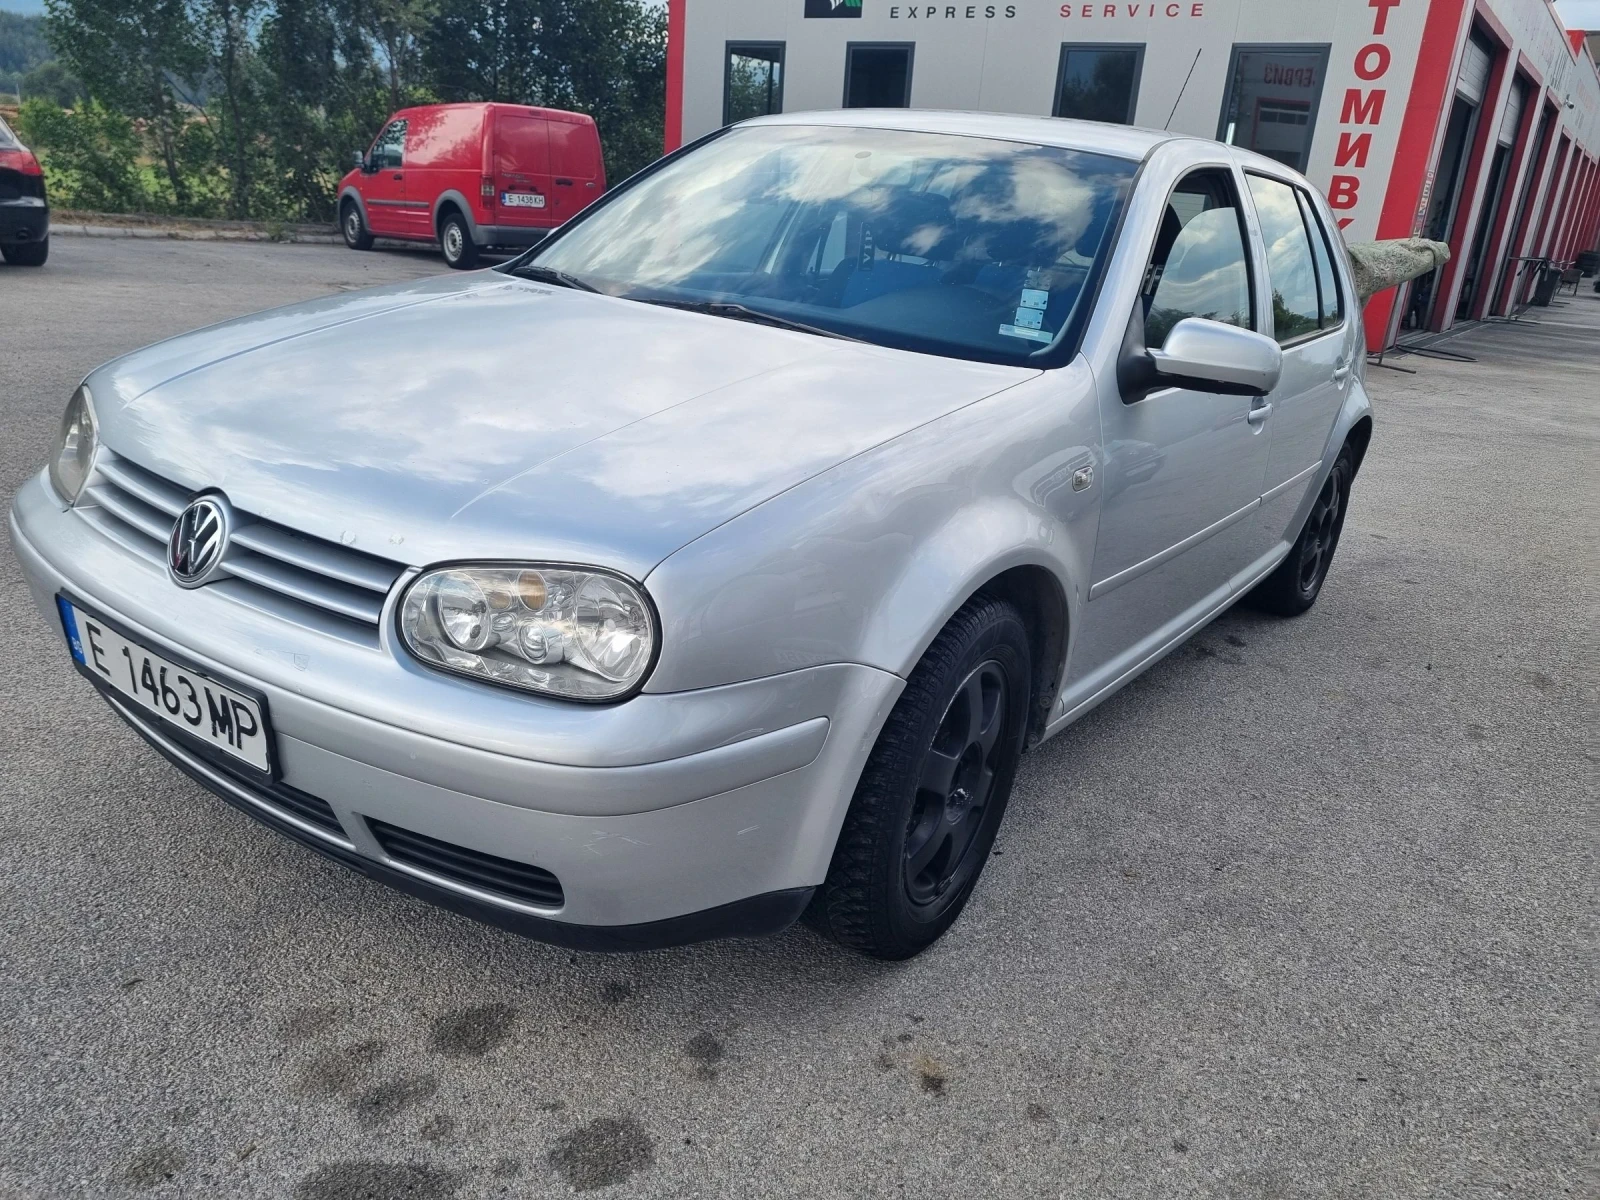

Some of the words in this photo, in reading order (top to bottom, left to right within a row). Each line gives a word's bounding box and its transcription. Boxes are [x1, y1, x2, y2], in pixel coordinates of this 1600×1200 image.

[890, 5, 1016, 19] EXPRESS
[1060, 3, 1204, 18] SERVICE
[863, 230, 872, 264] VIP
[86, 621, 111, 677] E
